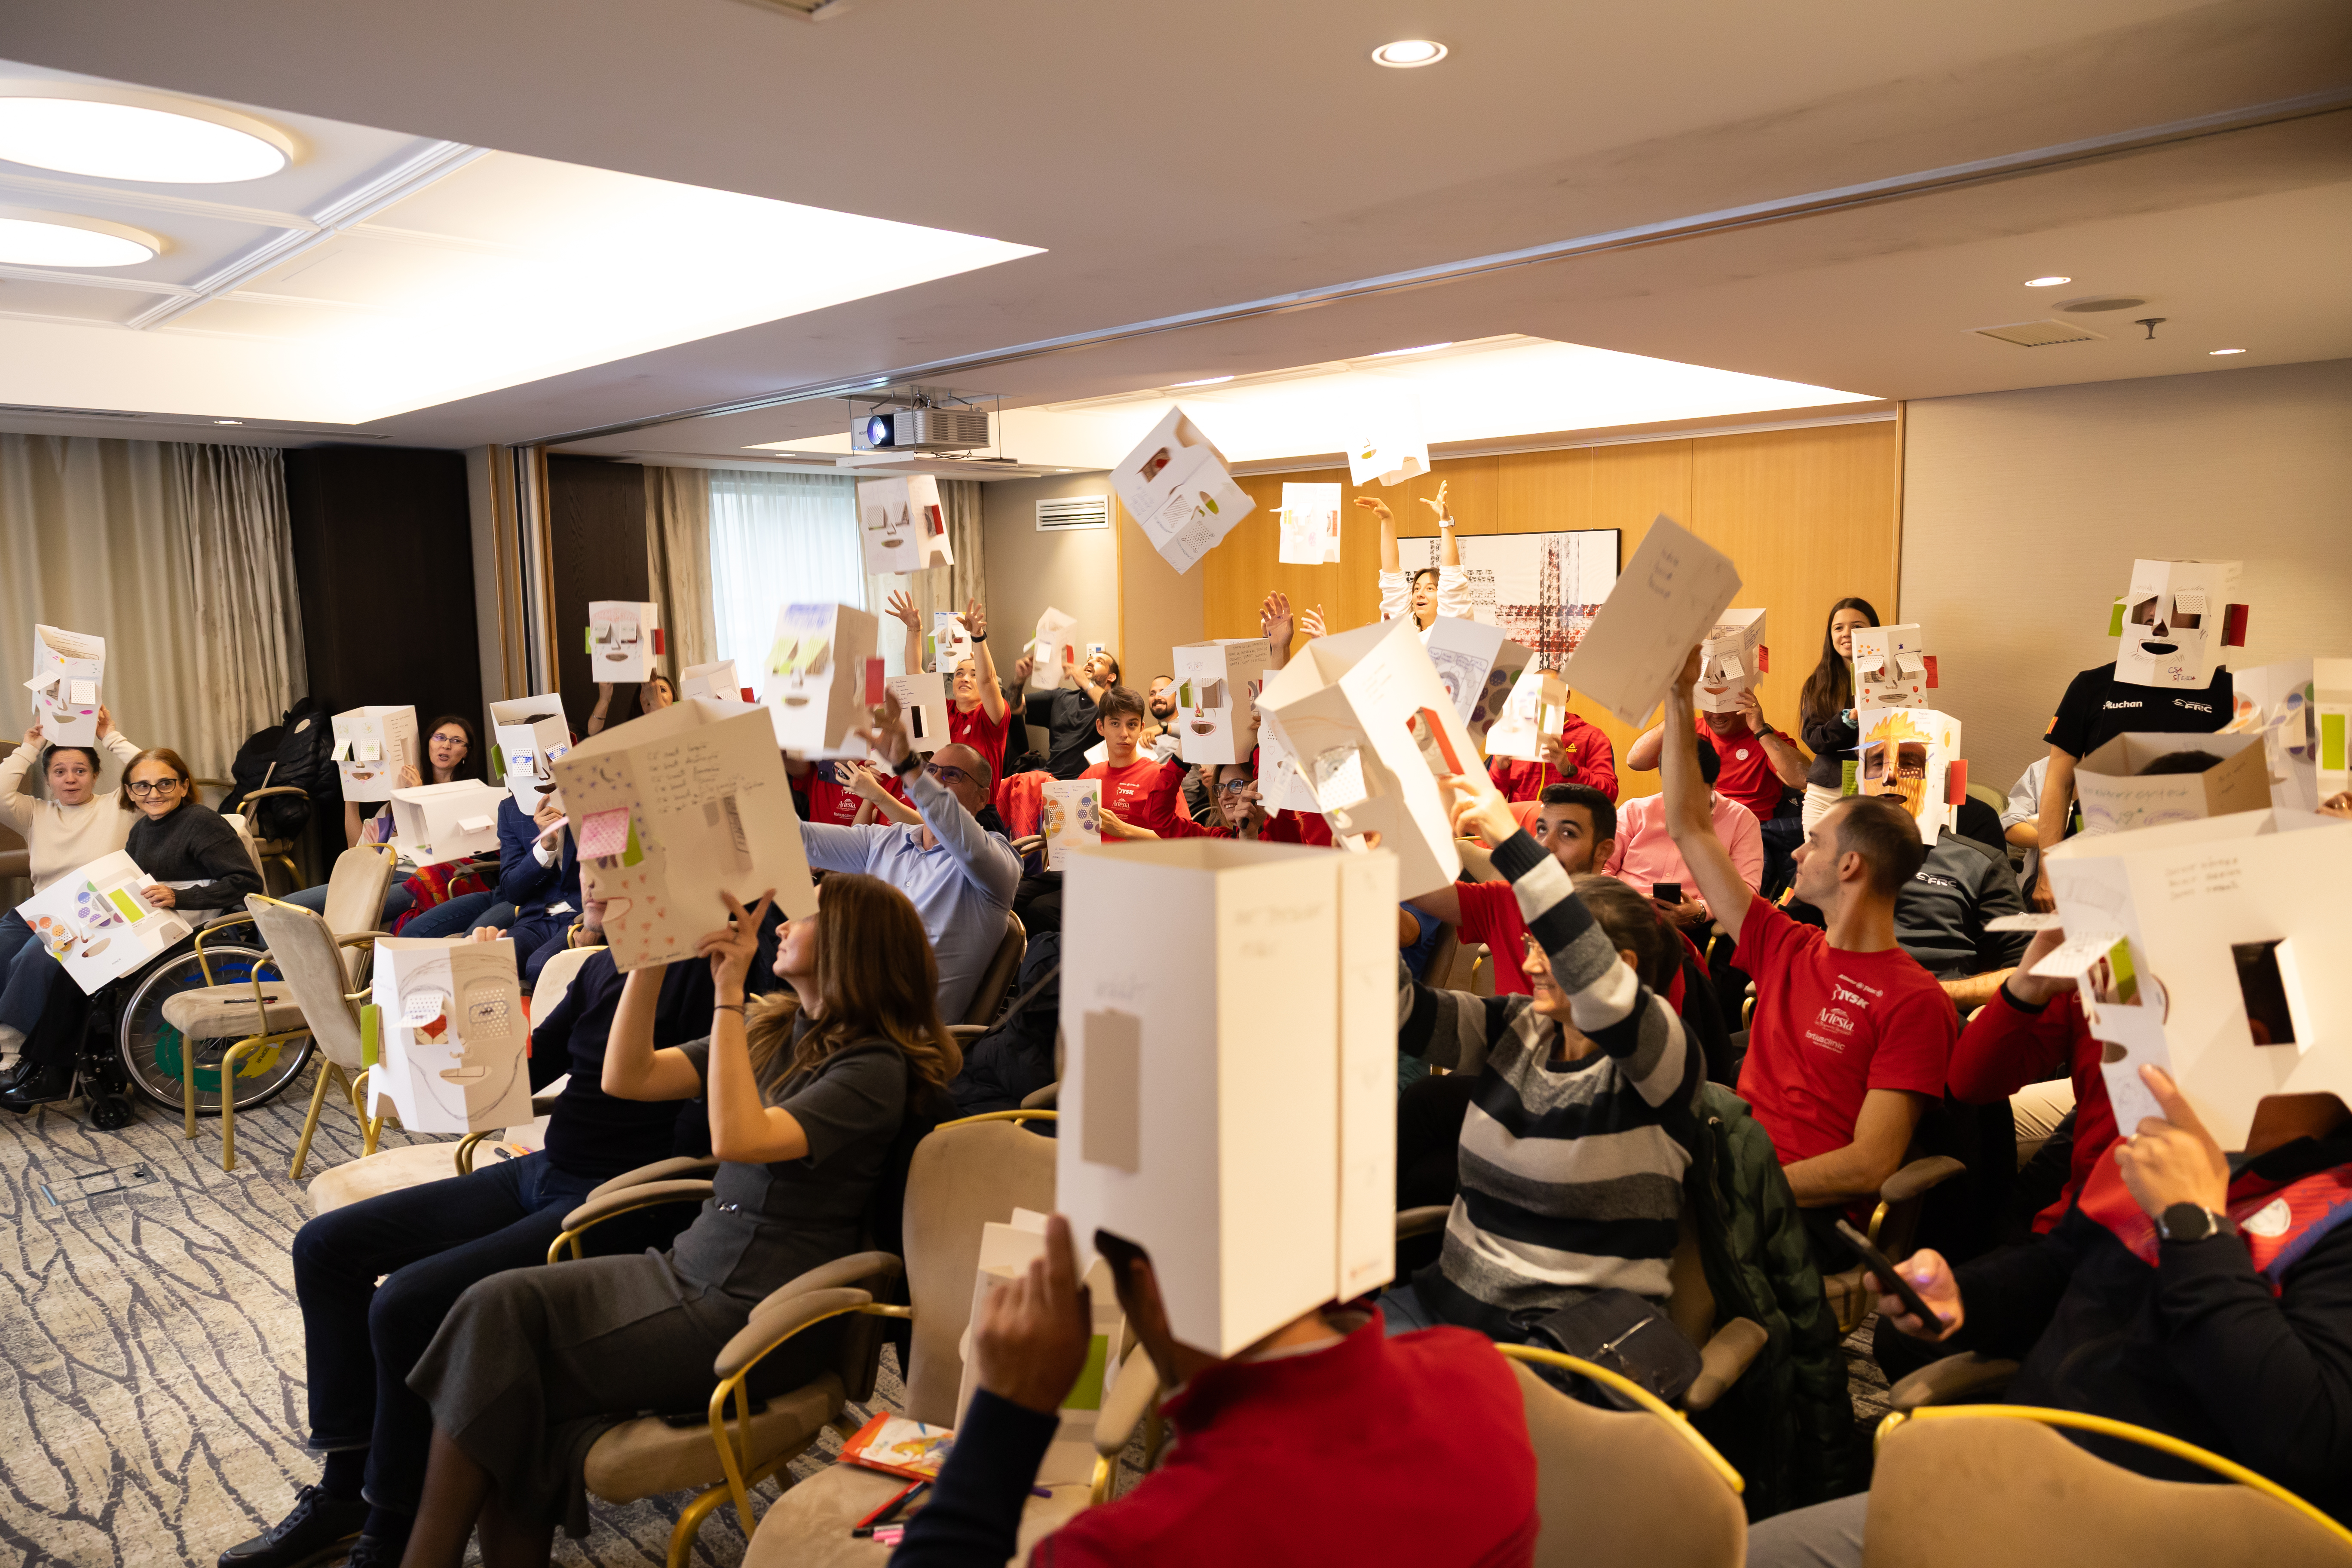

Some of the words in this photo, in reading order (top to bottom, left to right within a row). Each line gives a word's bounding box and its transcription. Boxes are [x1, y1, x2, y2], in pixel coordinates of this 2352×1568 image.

[2103, 701, 2143, 710] Auchan
[2185, 703, 2212, 713] FRC
[1928, 877, 1957, 887] FRC
[1838, 989, 1870, 1009] JYSK
[1816, 1007, 1855, 1031] Artesia
[1805, 1029, 1845, 1050] fortiusclinic
